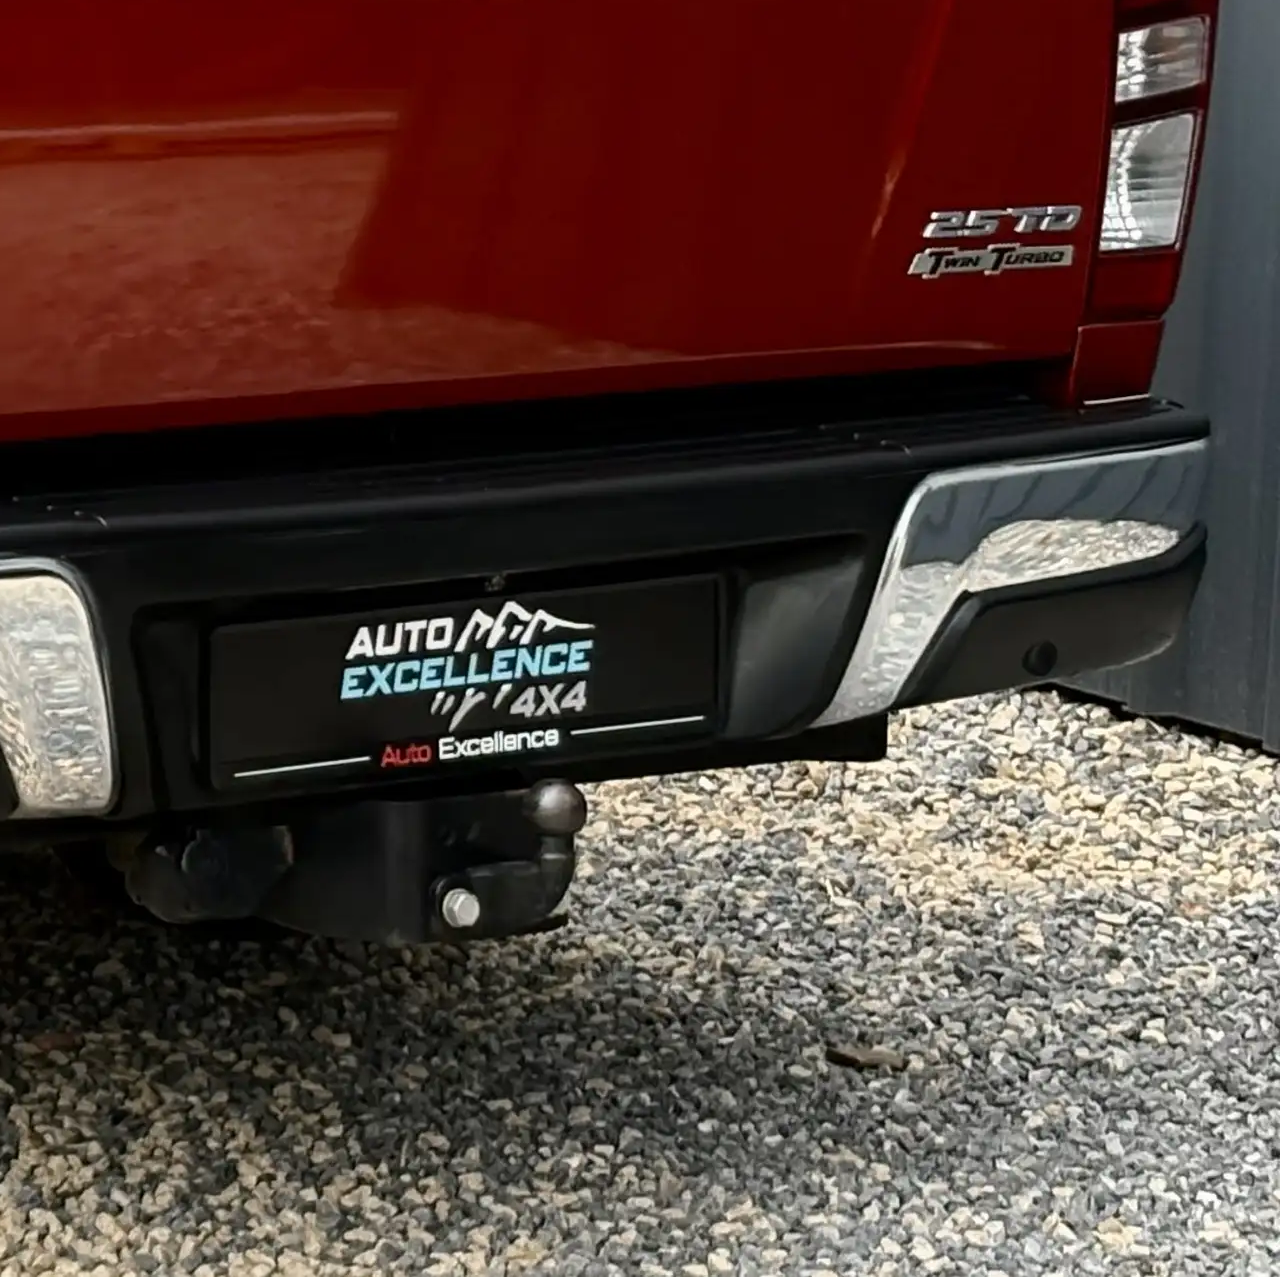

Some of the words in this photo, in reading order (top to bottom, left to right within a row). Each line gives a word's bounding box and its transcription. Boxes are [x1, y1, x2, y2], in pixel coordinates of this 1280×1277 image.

[1006, 205, 1082, 233] TD
[344, 617, 454, 660] AUTO
[340, 639, 594, 700] EXCELLENCE
[509, 680, 587, 718] 4X4
[380, 743, 432, 768] Auto
[438, 728, 560, 761] Excellence
